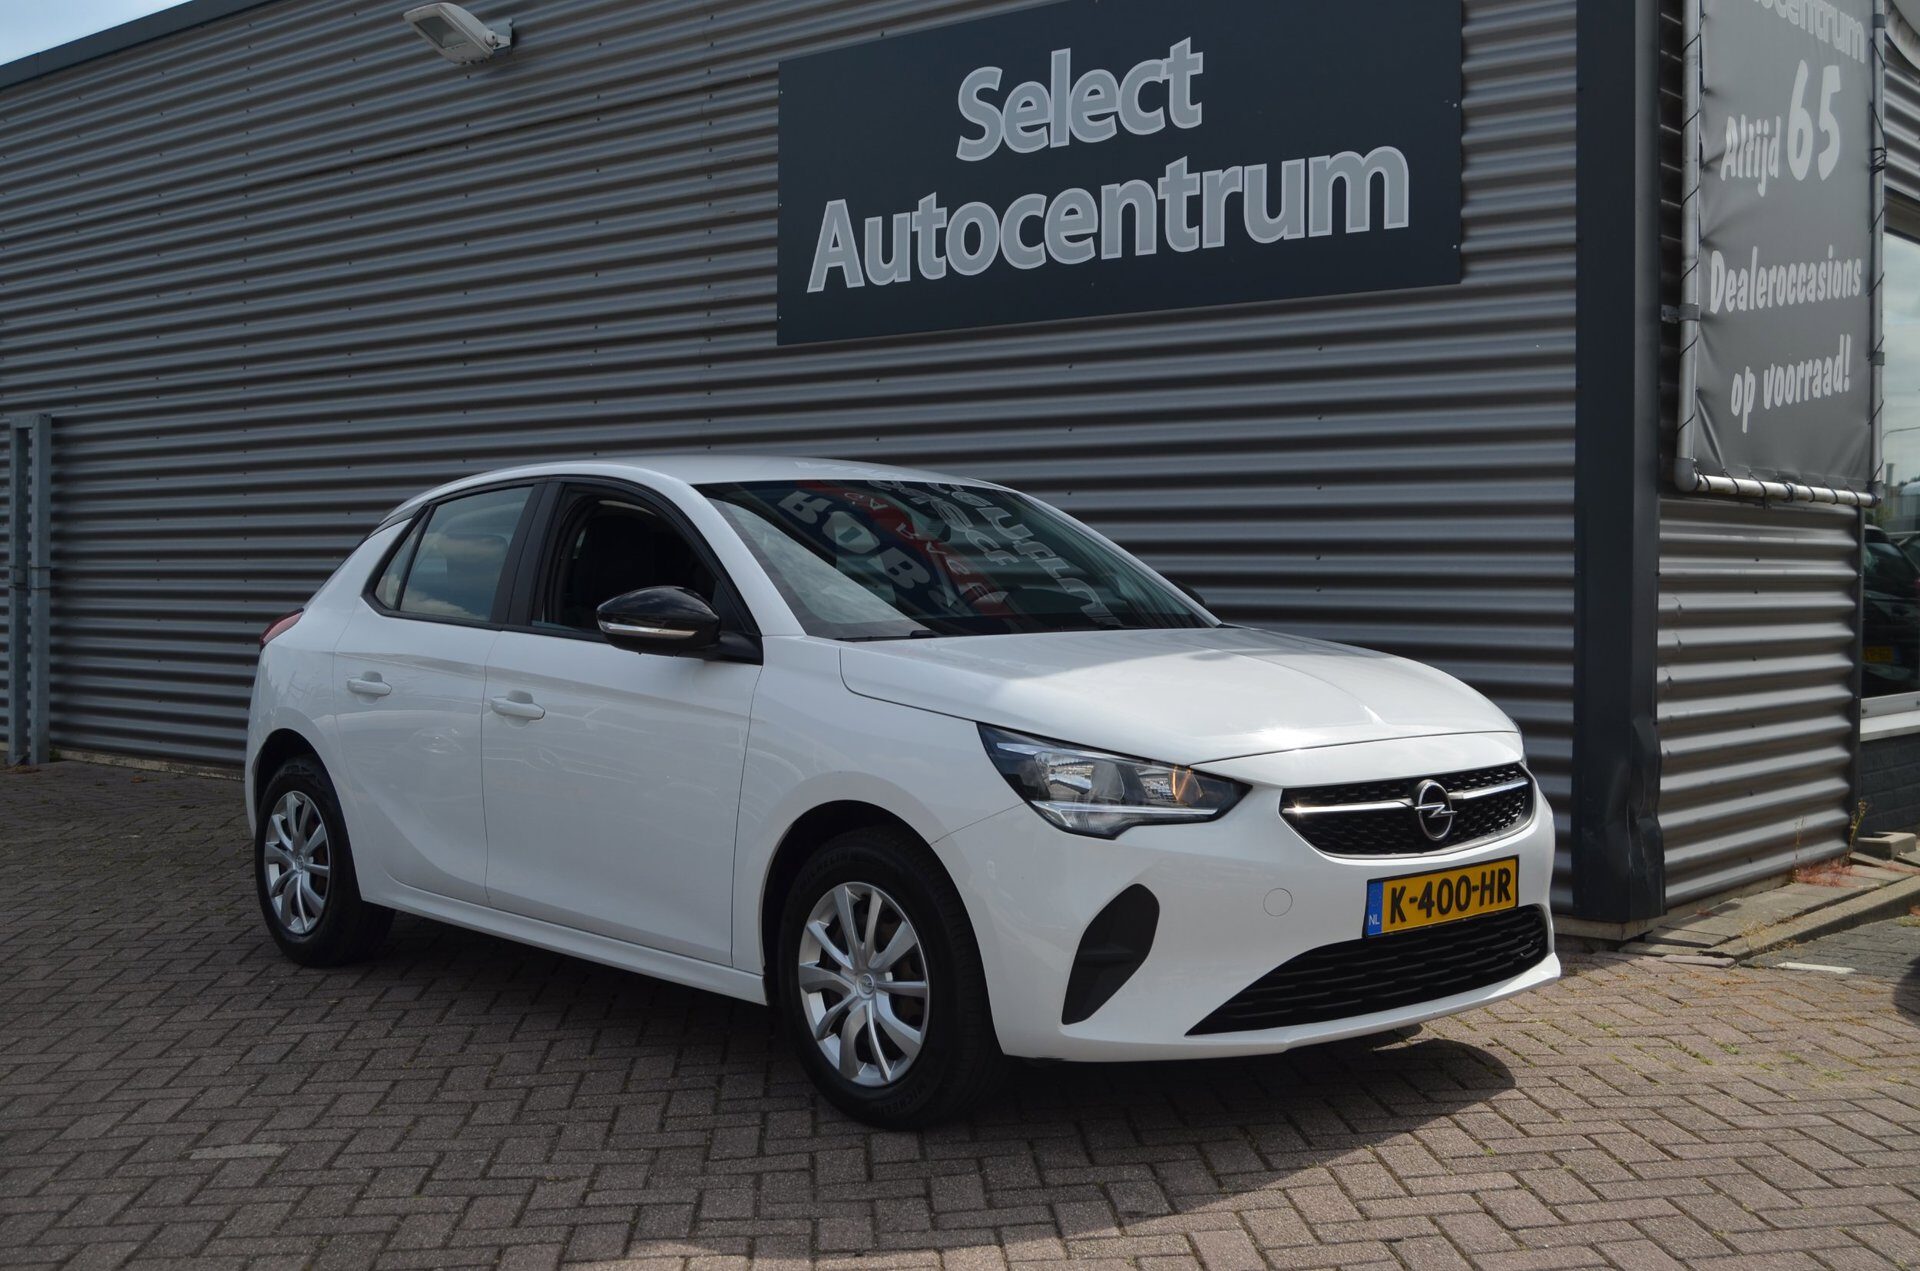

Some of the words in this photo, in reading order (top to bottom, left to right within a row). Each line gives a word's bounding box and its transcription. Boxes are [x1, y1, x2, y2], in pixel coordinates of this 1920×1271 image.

[1754, 0, 1865, 64] centrum
[956, 37, 1203, 162] Select
[1720, 114, 1781, 197] Altijd
[1787, 59, 1841, 181] 65
[806, 146, 1409, 293] Autocentrum
[1710, 245, 1862, 314] Dealeroccasions
[1731, 366, 1756, 433] op
[1763, 333, 1851, 410] voorraad!
[1368, 914, 1381, 926] NL
[1389, 868, 1512, 925] K-400-HR
